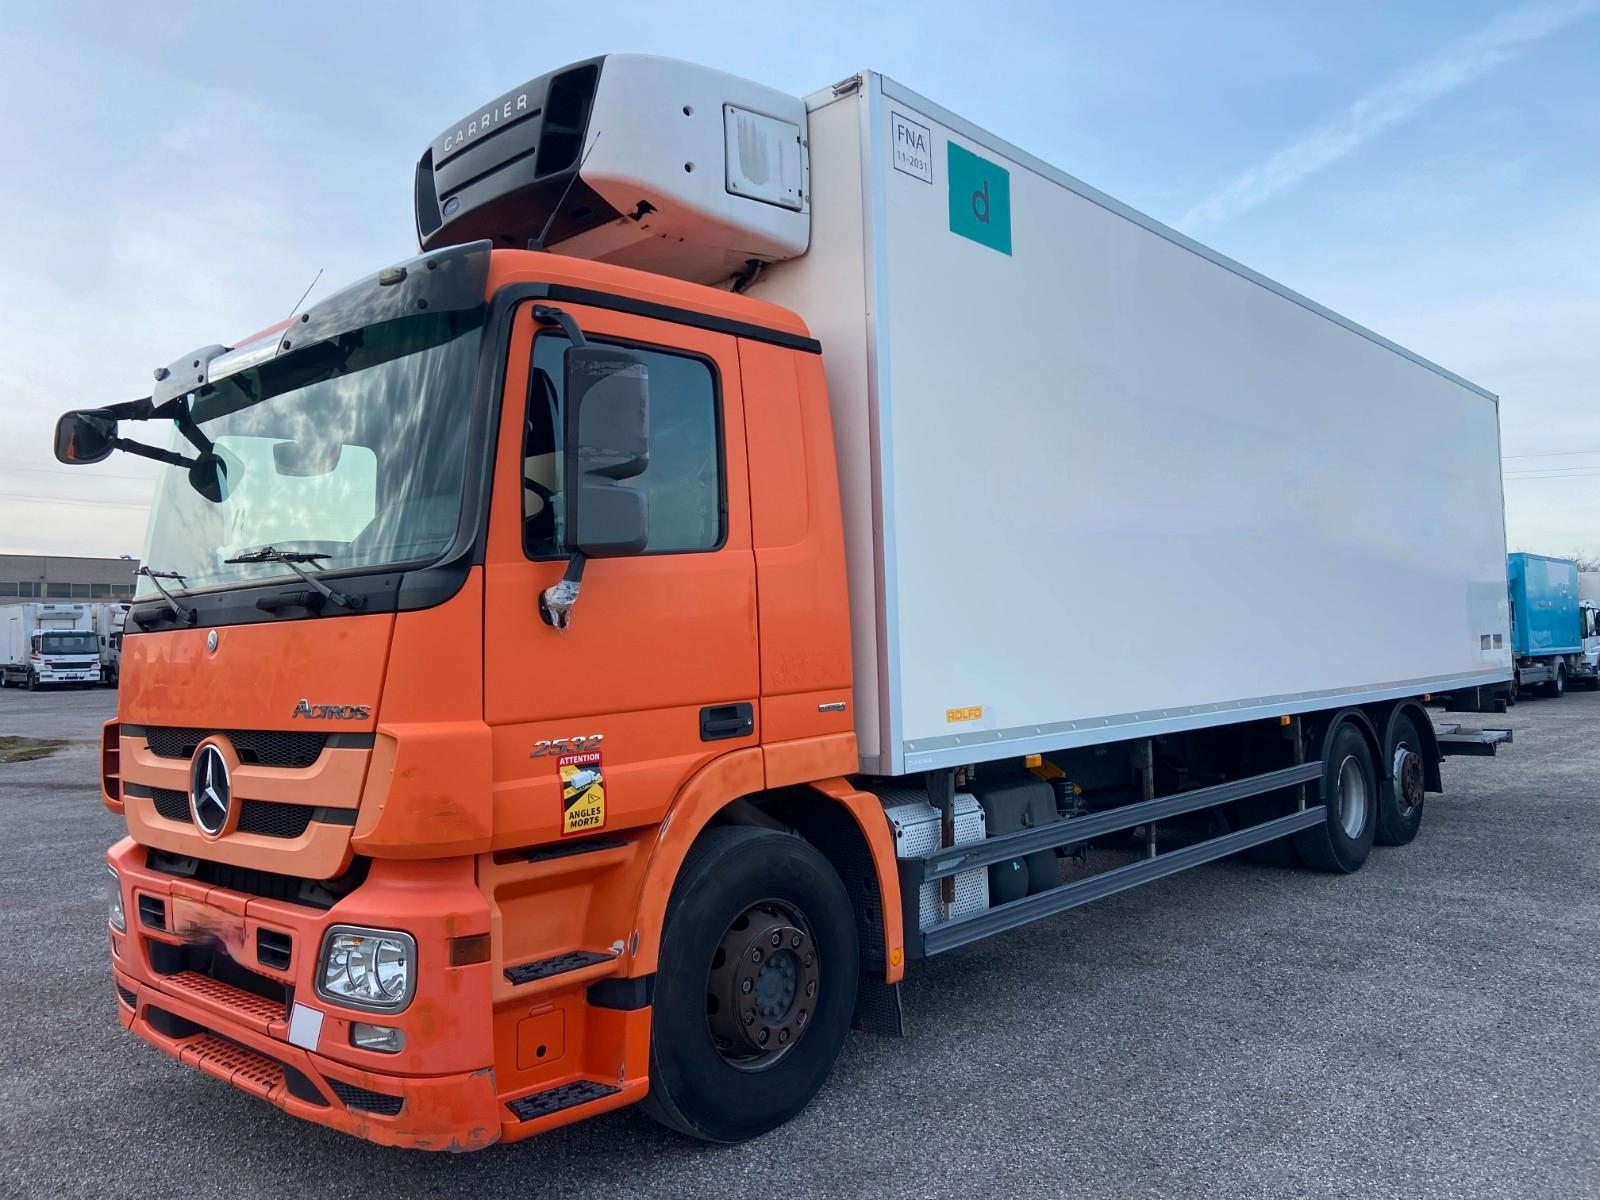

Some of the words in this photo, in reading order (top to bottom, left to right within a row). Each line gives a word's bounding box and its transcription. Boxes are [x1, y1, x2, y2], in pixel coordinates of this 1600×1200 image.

[444, 94, 528, 152] CARRIER
[897, 124, 926, 153] FNA
[897, 149, 928, 173] 11-2031
[971, 178, 990, 225] d
[529, 734, 604, 757] 2532
[560, 753, 600, 765] ATTENTION
[569, 807, 601, 820] ANGLES
[570, 816, 600, 829] MORTS
